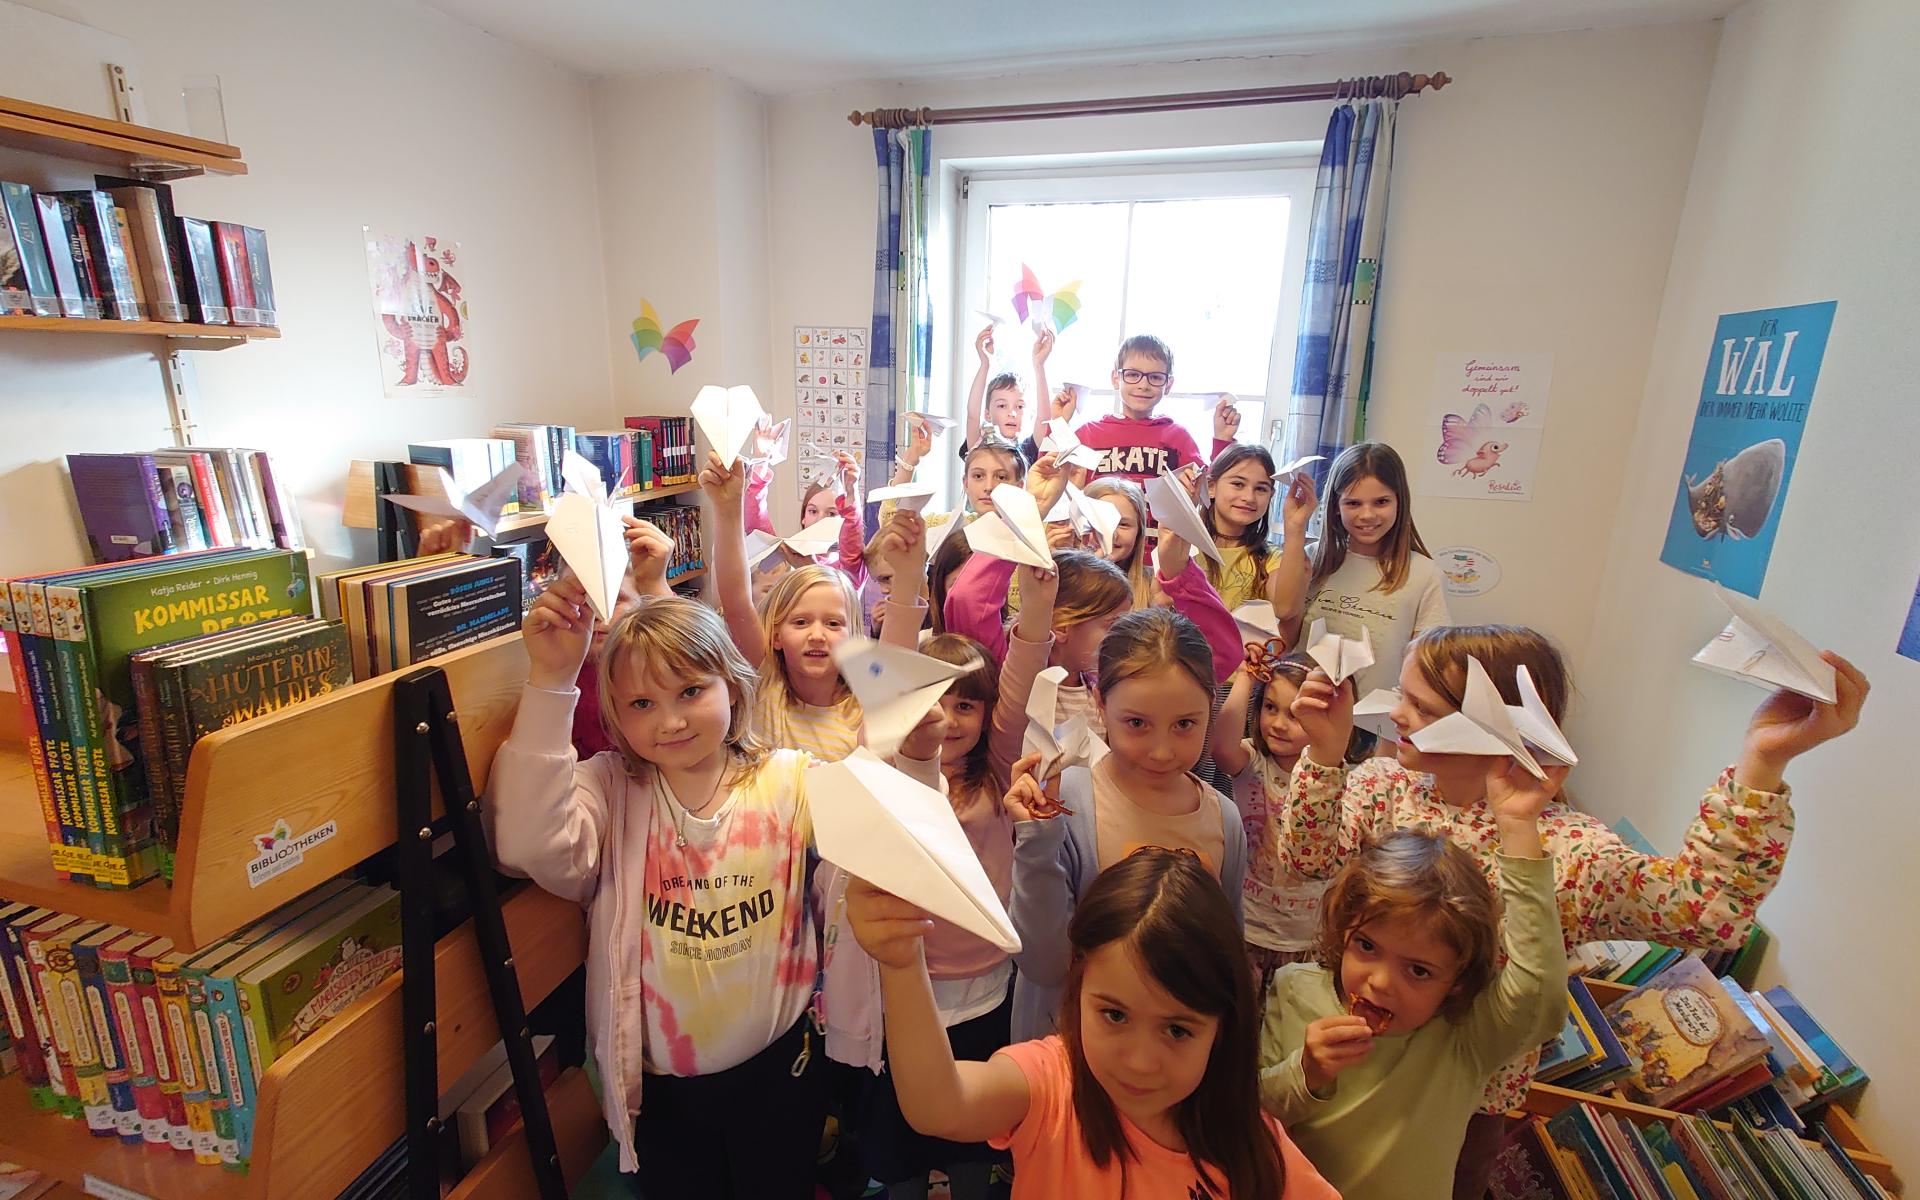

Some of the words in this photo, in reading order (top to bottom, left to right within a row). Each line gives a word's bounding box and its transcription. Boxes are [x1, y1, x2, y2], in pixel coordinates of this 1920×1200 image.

[72, 234, 83, 263] Camp
[1760, 319, 1778, 337] DER
[1465, 360, 1520, 377] Gemeinsam
[1716, 330, 1799, 396] WAL
[1098, 447, 1169, 476] SKATE
[150, 586, 174, 597] Katja
[175, 581, 202, 590] Reider
[134, 585, 270, 635] KOMMISSAR
[247, 652, 272, 663] Mona
[275, 645, 300, 656] Larch
[206, 646, 333, 704] HÜTERIN
[232, 668, 335, 723] WALDES
[46, 740, 59, 768] PFOTE
[61, 742, 73, 770] PFOTE
[77, 746, 89, 775] PFOTE
[93, 748, 106, 777] PFOTE
[36, 768, 56, 822] KOMMISSAR
[52, 772, 73, 825] KOMMISSAR
[66, 774, 85, 828] KOMMISSAR
[81, 779, 101, 832] KOMMISSAR
[98, 781, 117, 834] KOMMISSAR
[715, 875, 728, 888] OF
[733, 875, 754, 888] THE
[648, 888, 775, 941] WEEKEND
[670, 940, 702, 960] SINCE
[705, 936, 753, 962] MONDAY
[1699, 1022, 1710, 1032] der
